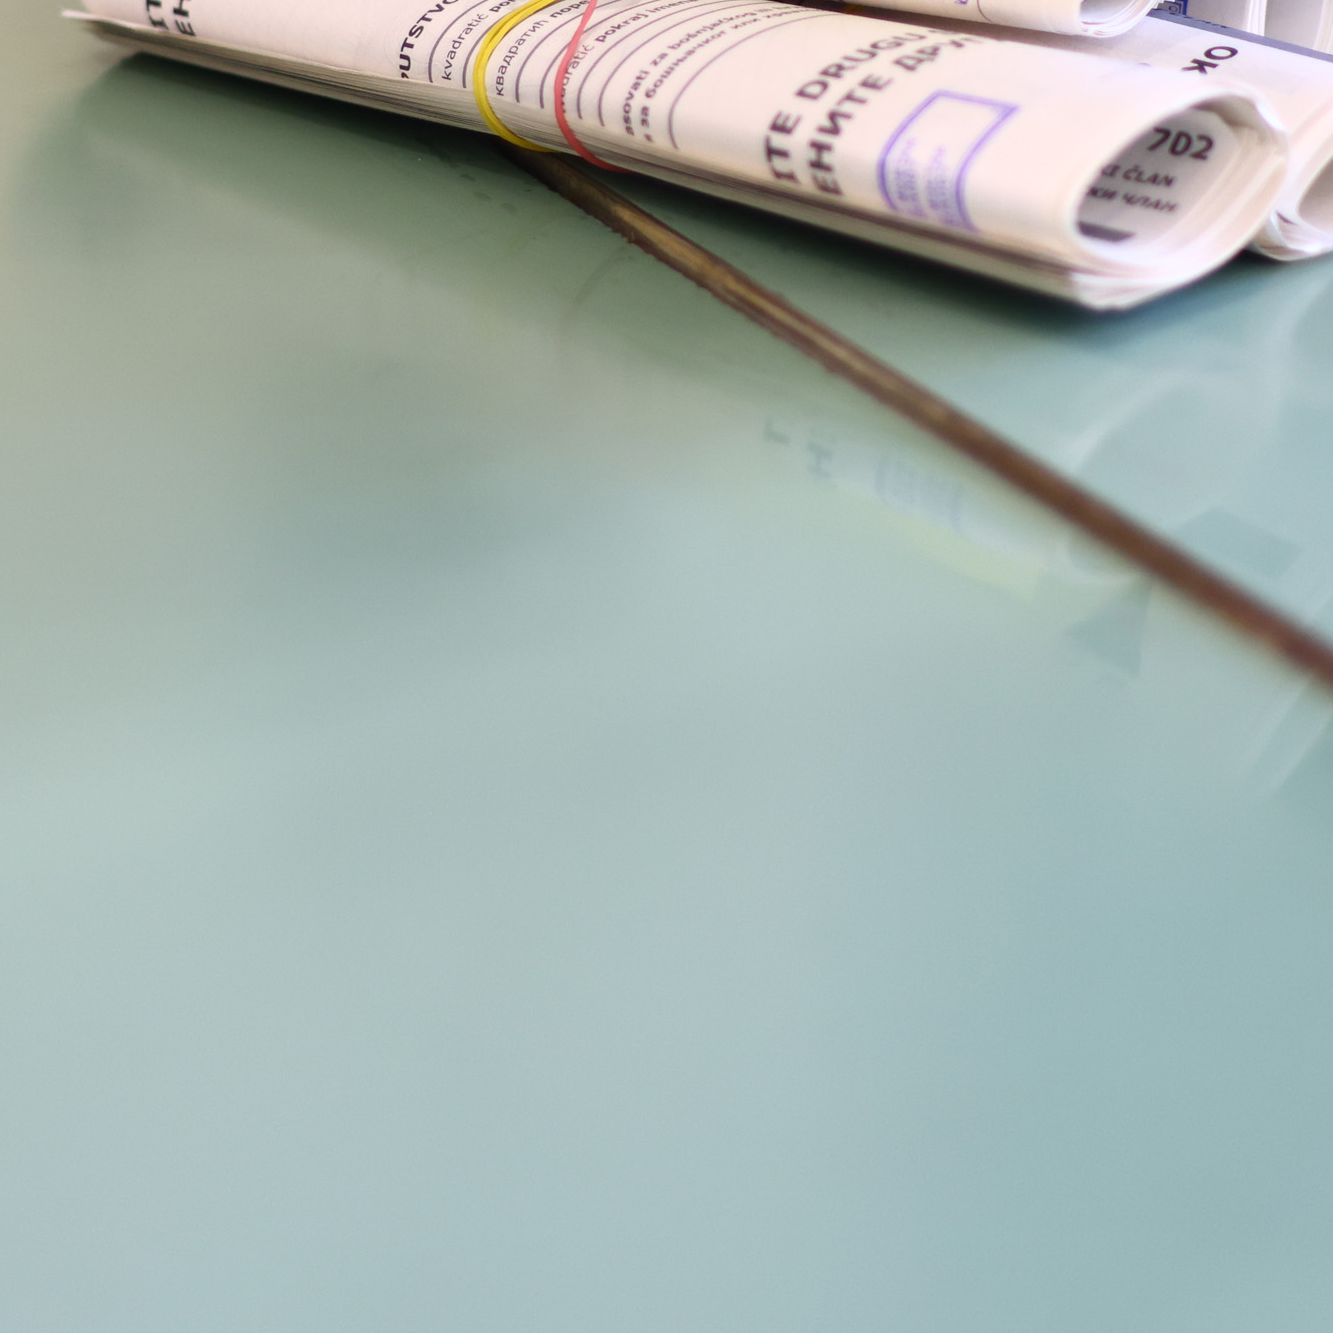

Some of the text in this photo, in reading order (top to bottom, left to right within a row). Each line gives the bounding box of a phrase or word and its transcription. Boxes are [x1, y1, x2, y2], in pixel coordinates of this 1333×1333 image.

[595, 14, 650, 44] pokraj
[442, 12, 490, 81] kvadratić
[496, 18, 550, 97] квадратић
[651, 52, 669, 68] za
[808, 73, 894, 196] ЕНИТЕ
[1147, 126, 1215, 161] 702
[1122, 165, 1176, 187] ČLAN
[1122, 192, 1178, 212] ЧЛАН
